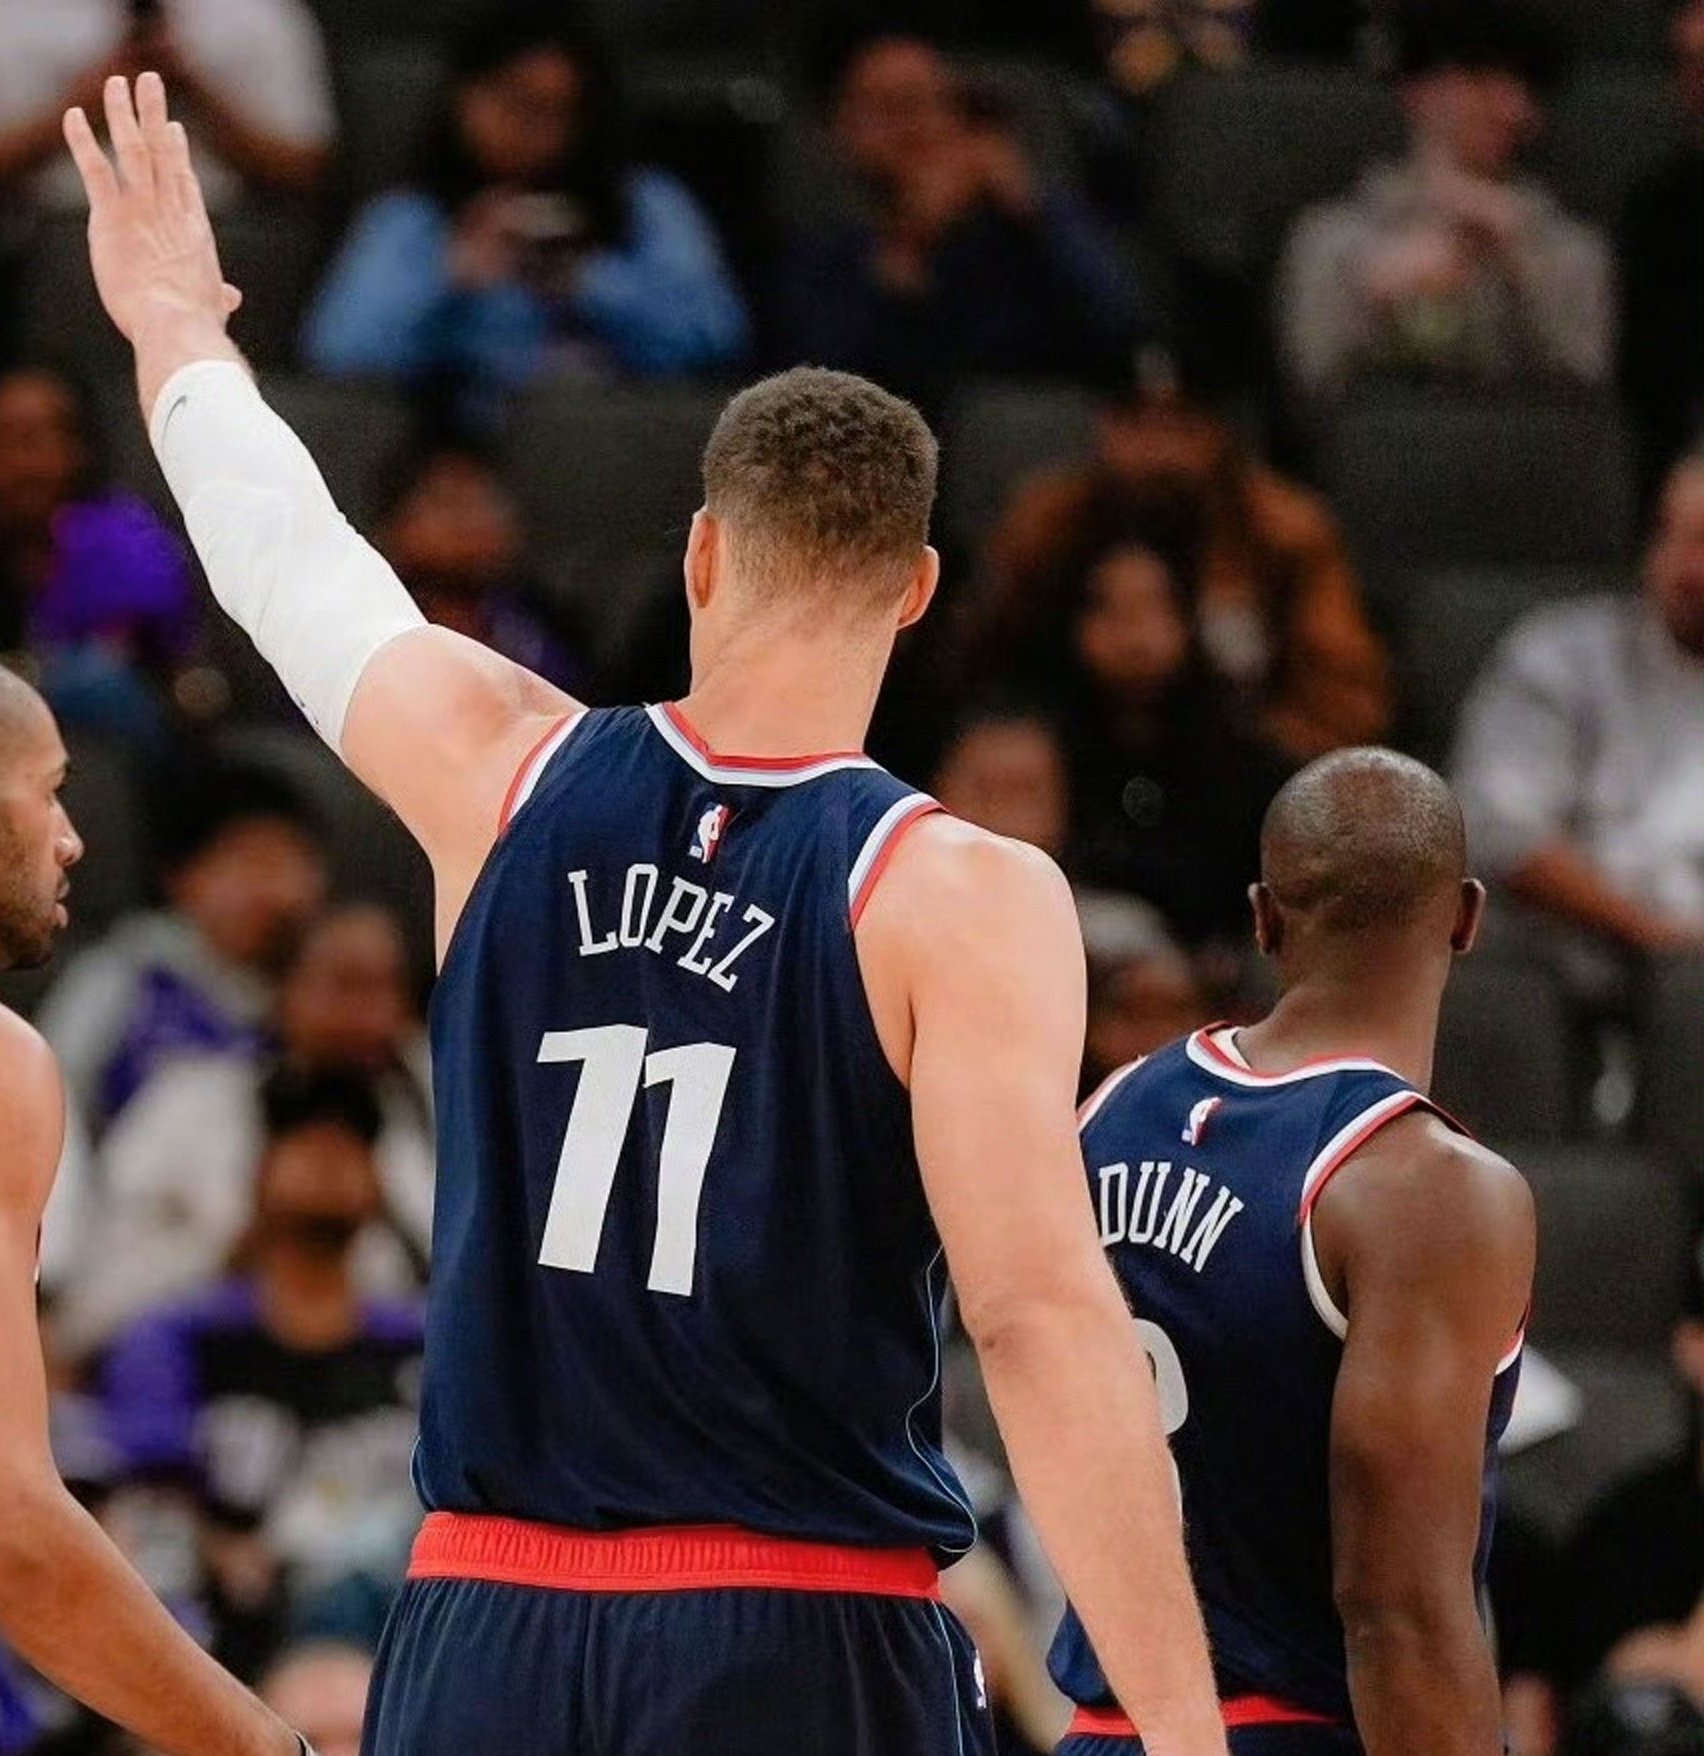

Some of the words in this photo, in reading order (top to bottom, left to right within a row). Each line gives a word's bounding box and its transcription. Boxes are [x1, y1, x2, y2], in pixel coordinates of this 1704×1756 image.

[568, 863, 775, 992] LOPEZ
[536, 1023, 737, 1297] 11
[1098, 1161, 1245, 1273] DUNN
